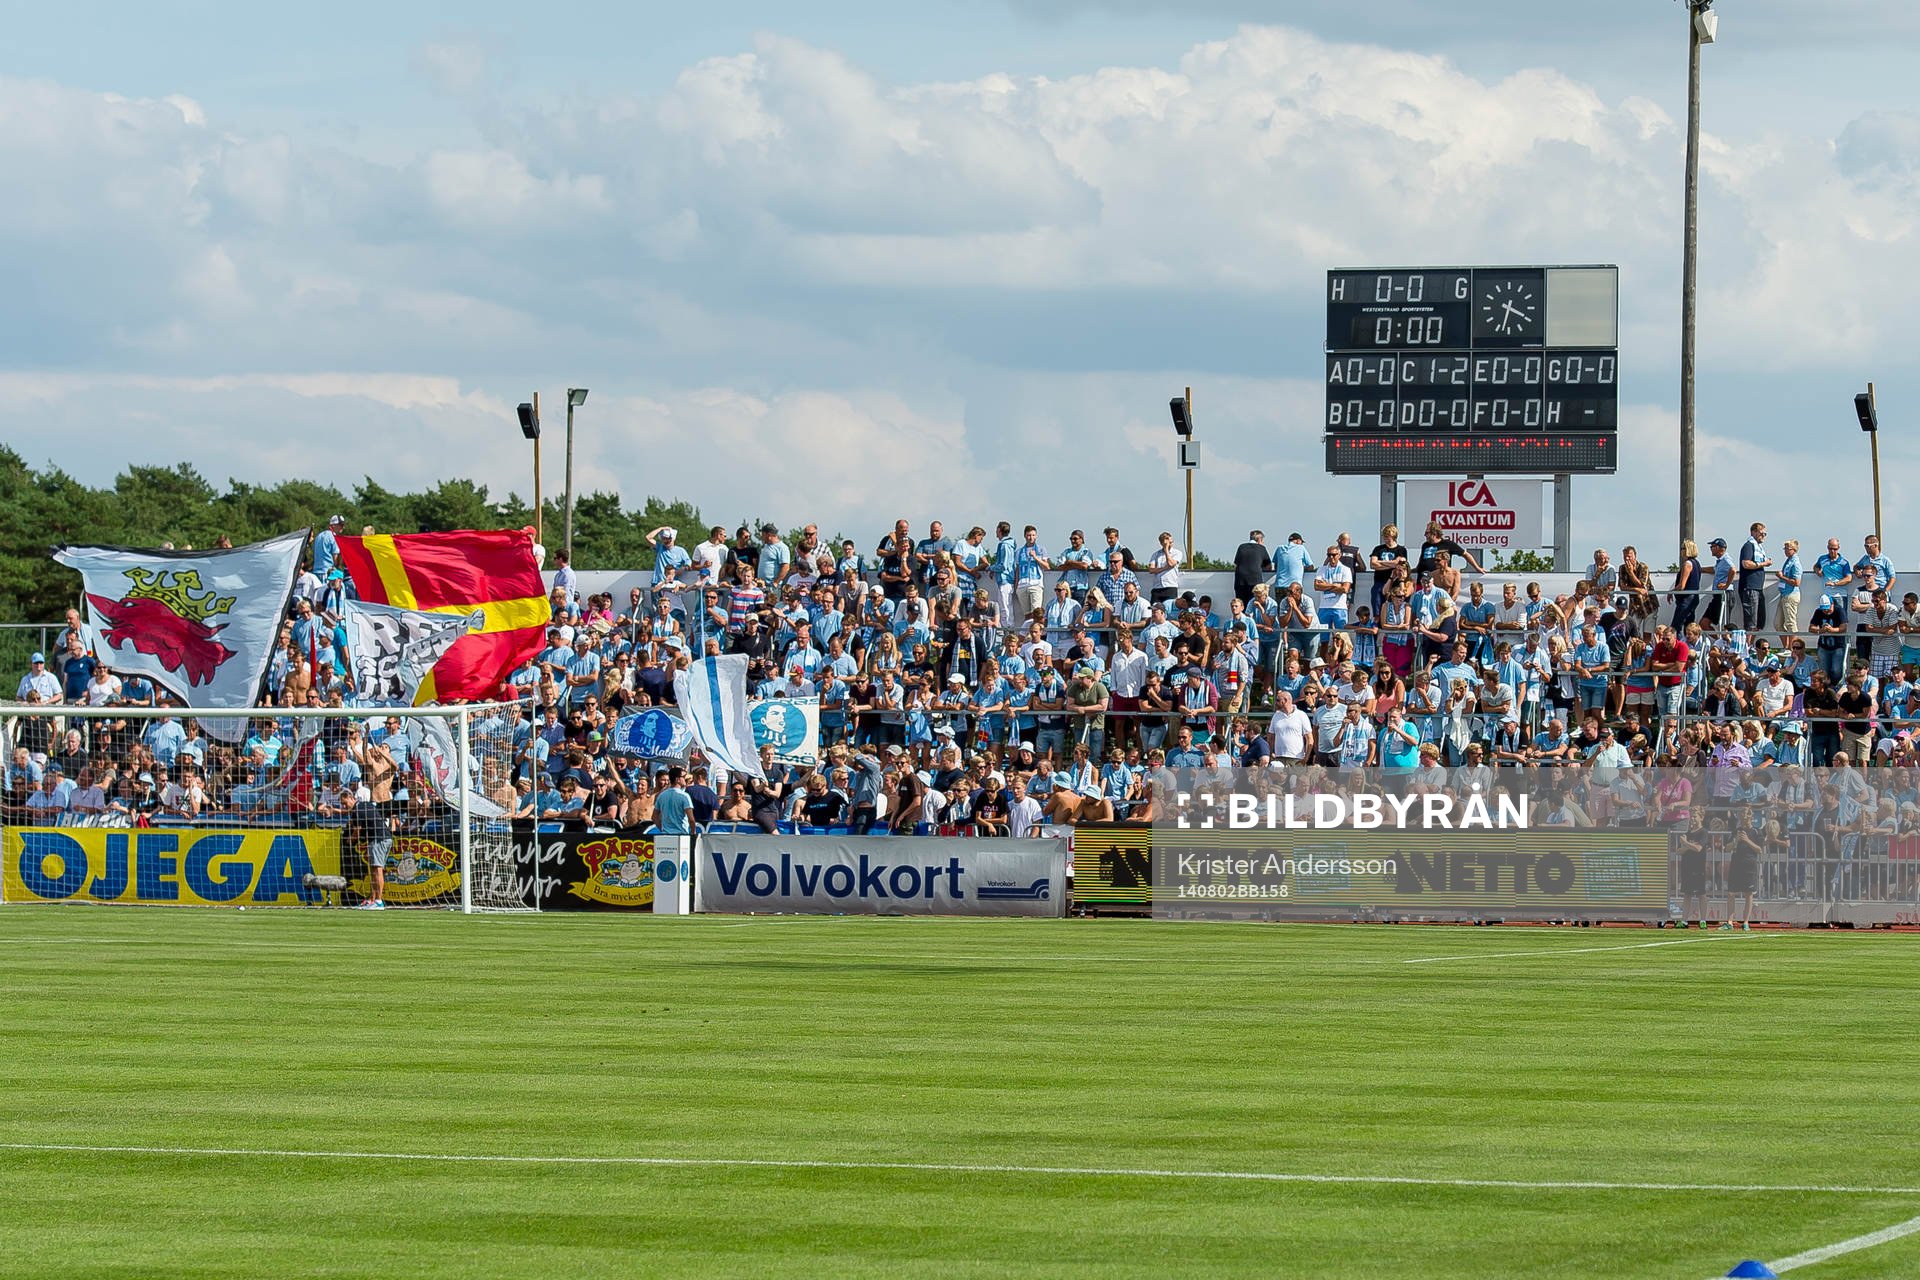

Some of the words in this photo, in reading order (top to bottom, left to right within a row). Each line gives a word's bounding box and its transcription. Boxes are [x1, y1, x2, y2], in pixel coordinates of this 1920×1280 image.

[1331, 279, 1345, 301] H
[1375, 275, 1424, 302] 0-0
[1455, 277, 1468, 299] G
[1375, 317, 1443, 343] 0:00
[1181, 444, 1196, 466] L
[1449, 481, 1498, 507] ICA
[1435, 514, 1511, 526] KVANTUM
[1444, 533, 1509, 547] alkenberg
[577, 837, 655, 878] PÄRSO
[711, 852, 965, 899] Volvokort
[1396, 850, 1576, 894] NETTO
[593, 885, 608, 897] Bra
[611, 892, 641, 902] mycket
